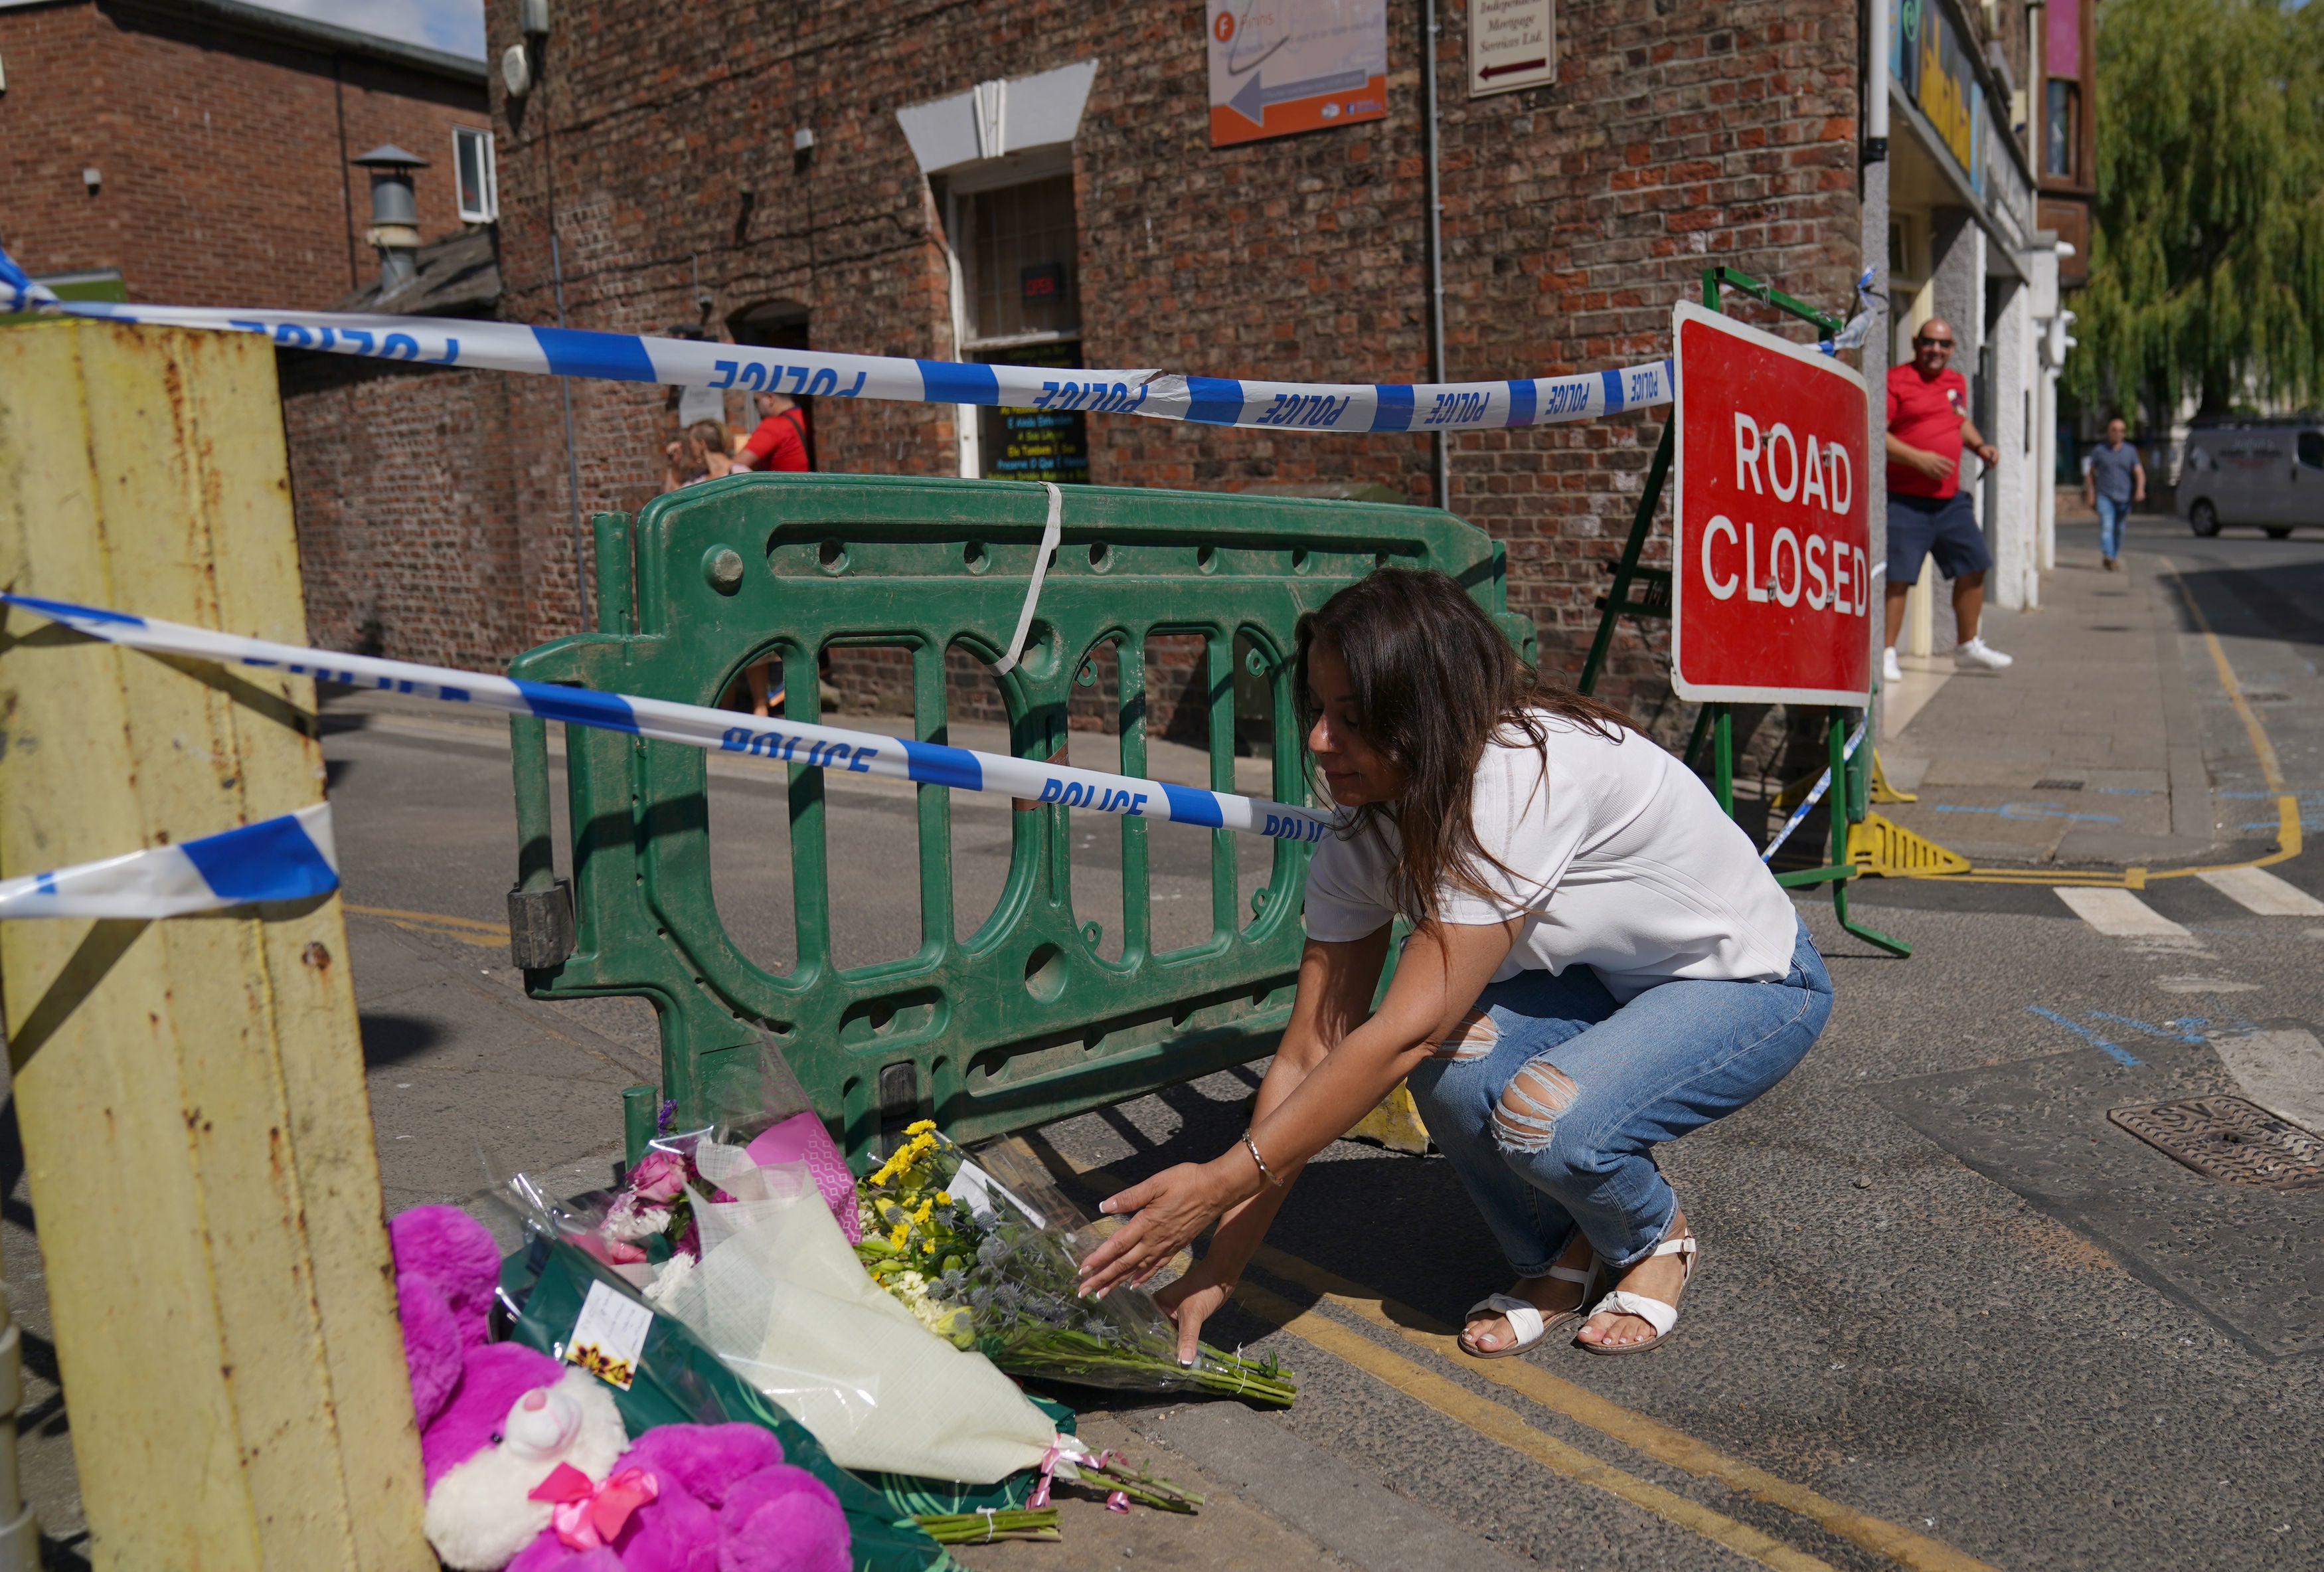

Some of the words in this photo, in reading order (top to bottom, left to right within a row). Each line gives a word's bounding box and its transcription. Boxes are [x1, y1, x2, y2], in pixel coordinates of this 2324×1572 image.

[1487, 15, 1536, 32] Mortgage
[1025, 276, 1054, 296] OPEN
[1545, 382, 1590, 416] POLICE
[1631, 370, 1657, 402] POLICE
[1256, 393, 1351, 426] POLICE
[1424, 391, 1490, 424] POLICE
[1734, 411, 1852, 515] ROAD
[1701, 514, 1867, 618] CLOSED
